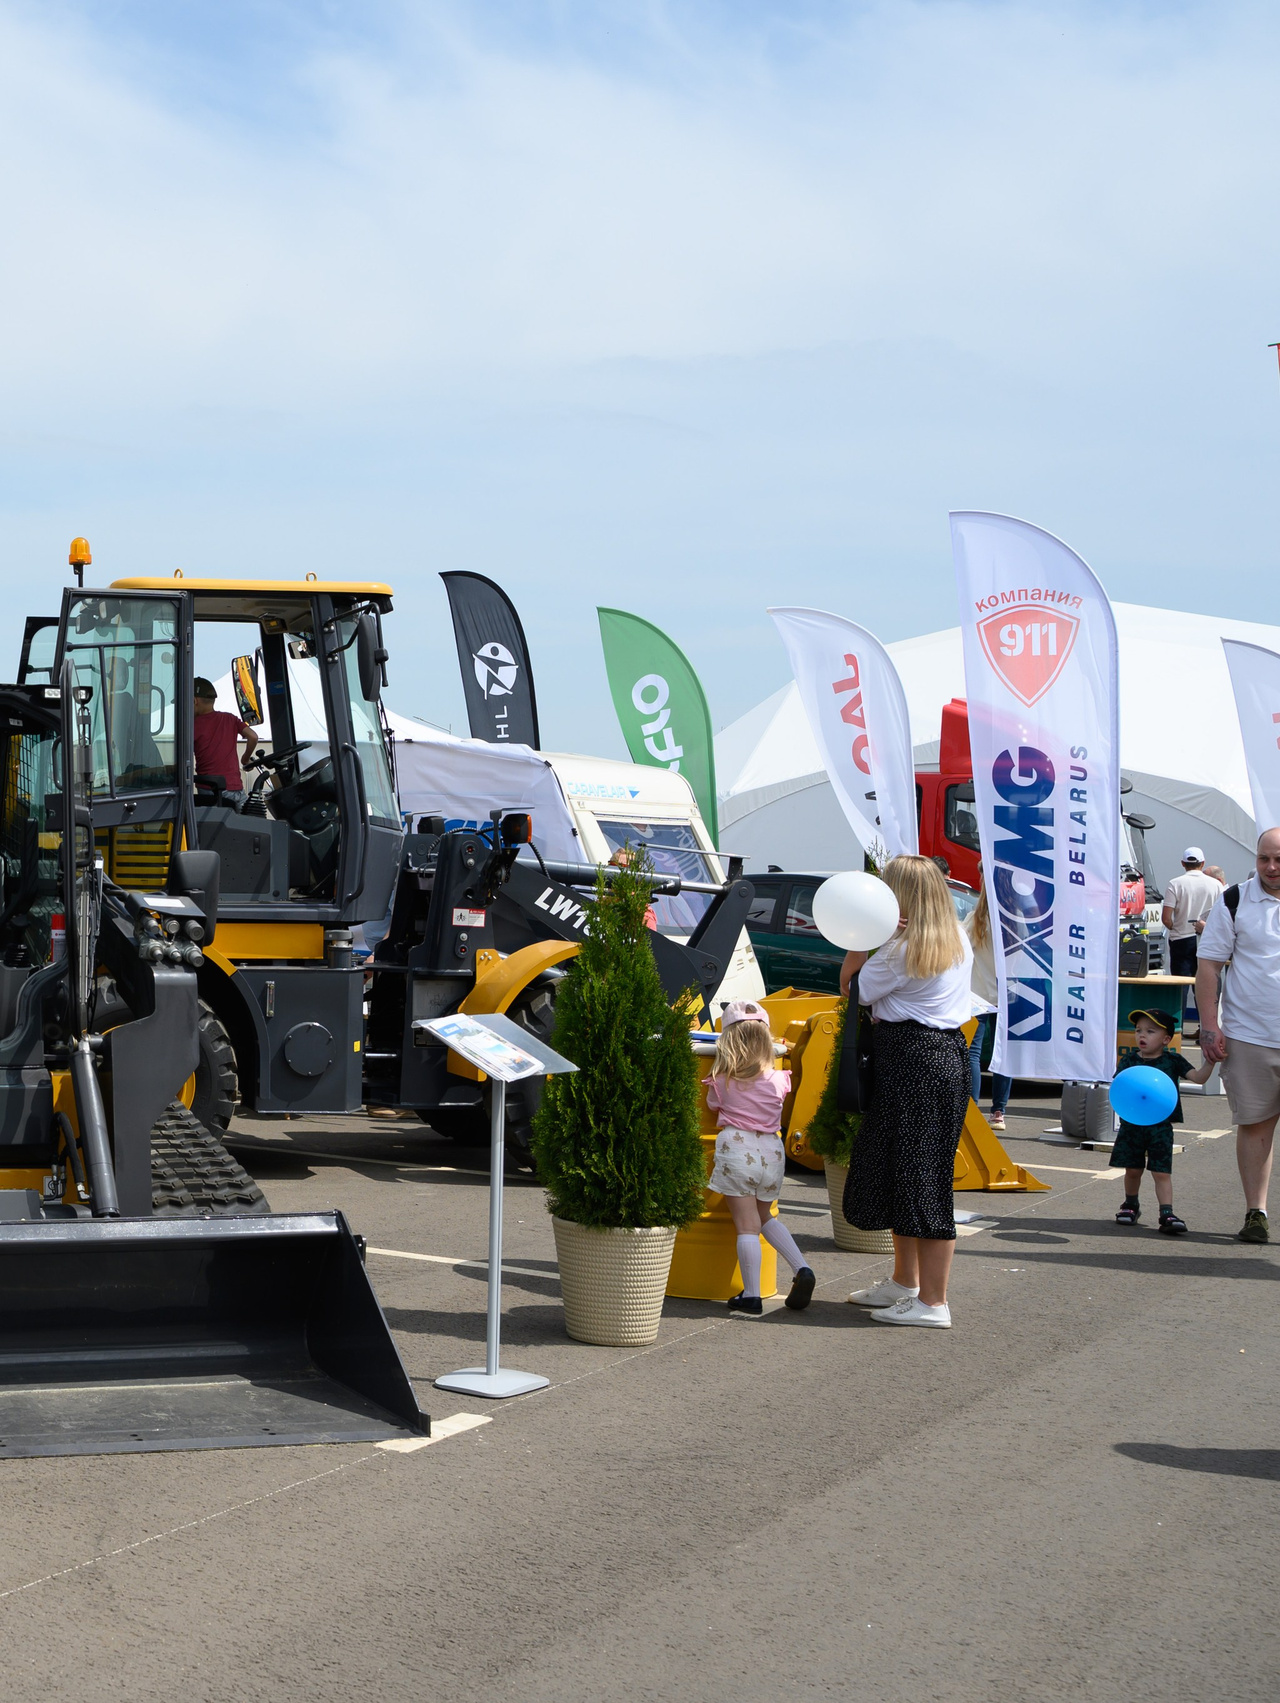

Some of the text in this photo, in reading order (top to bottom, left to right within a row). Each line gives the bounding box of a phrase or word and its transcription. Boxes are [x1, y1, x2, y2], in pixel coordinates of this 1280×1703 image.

[975, 588, 1083, 613] компания
[999, 622, 1057, 657] 911
[567, 781, 627, 799] CARAVELAIR
[992, 746, 1056, 978] XCMG
[1066, 745, 1088, 1044] DEALER BELARUS
[1121, 889, 1137, 904] JAC
